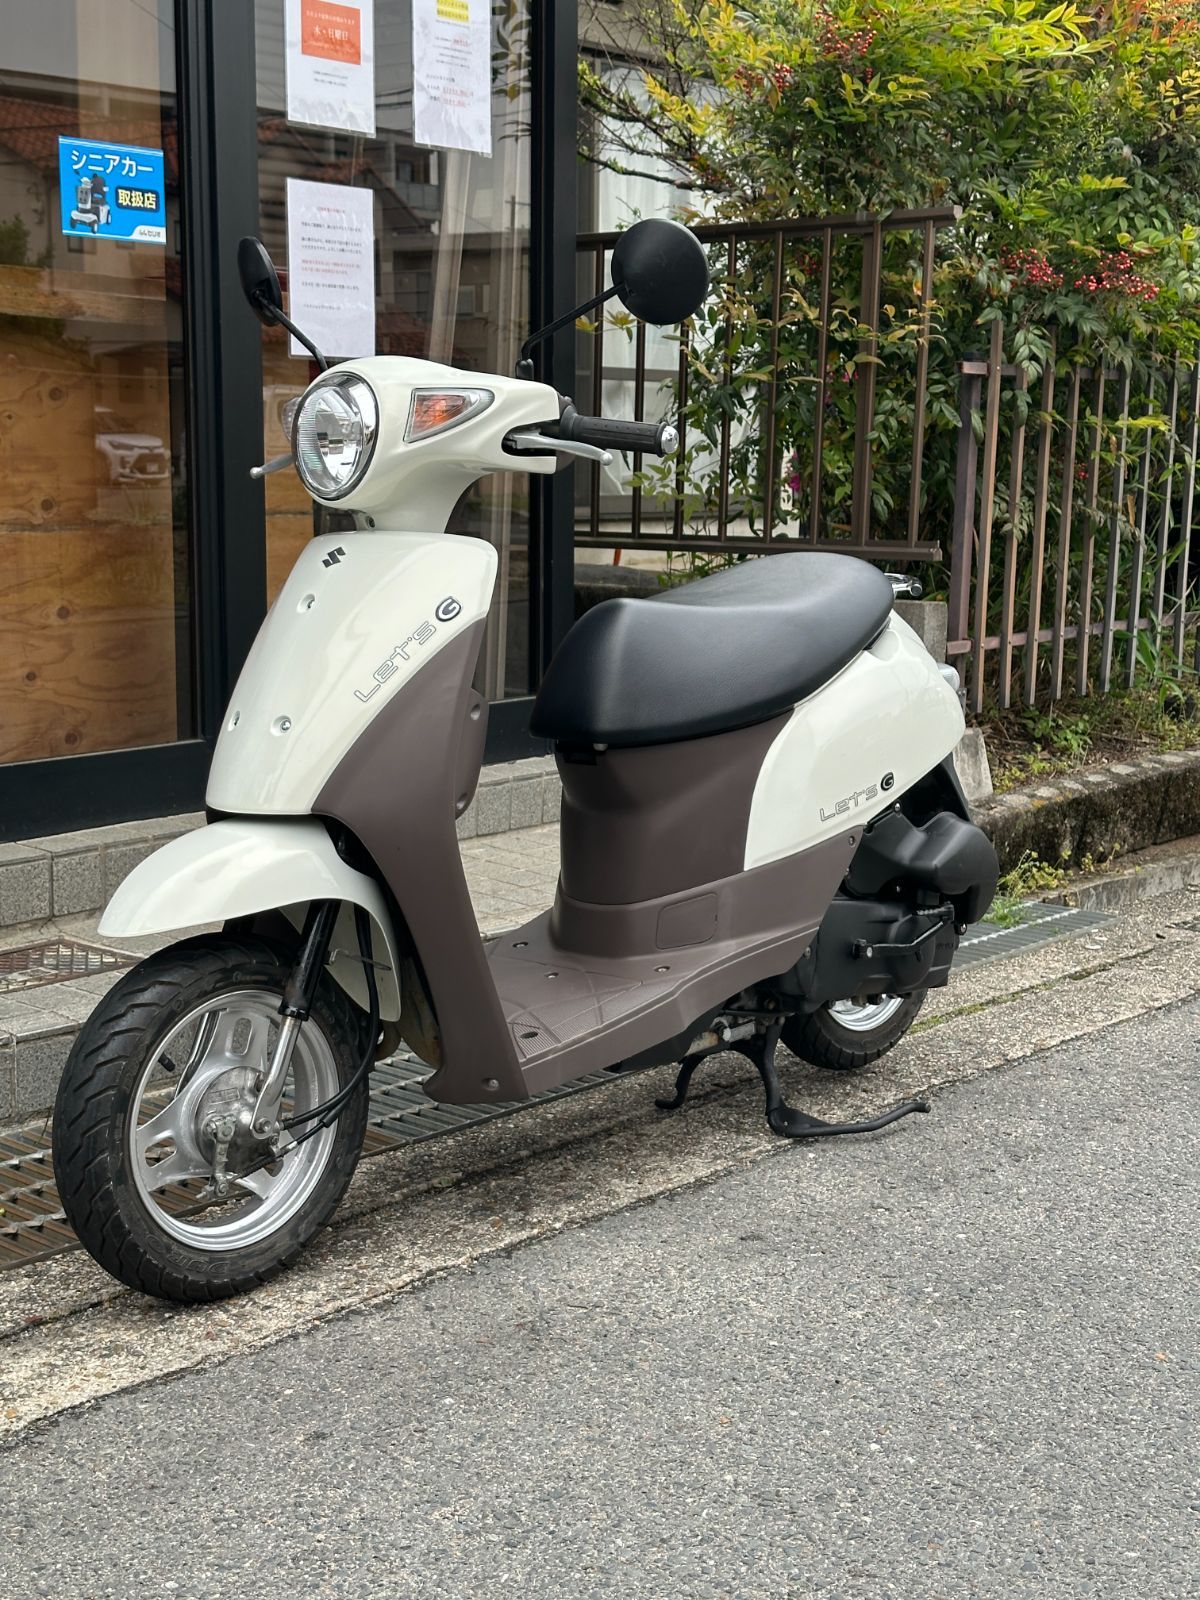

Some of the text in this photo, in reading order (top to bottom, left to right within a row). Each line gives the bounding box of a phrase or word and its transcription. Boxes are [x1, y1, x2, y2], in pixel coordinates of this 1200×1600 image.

[71, 150, 153, 177] シニアカー
[117, 188, 157, 210] 取扱店
[435, 596, 462, 622] G
[880, 772, 895, 791] G
